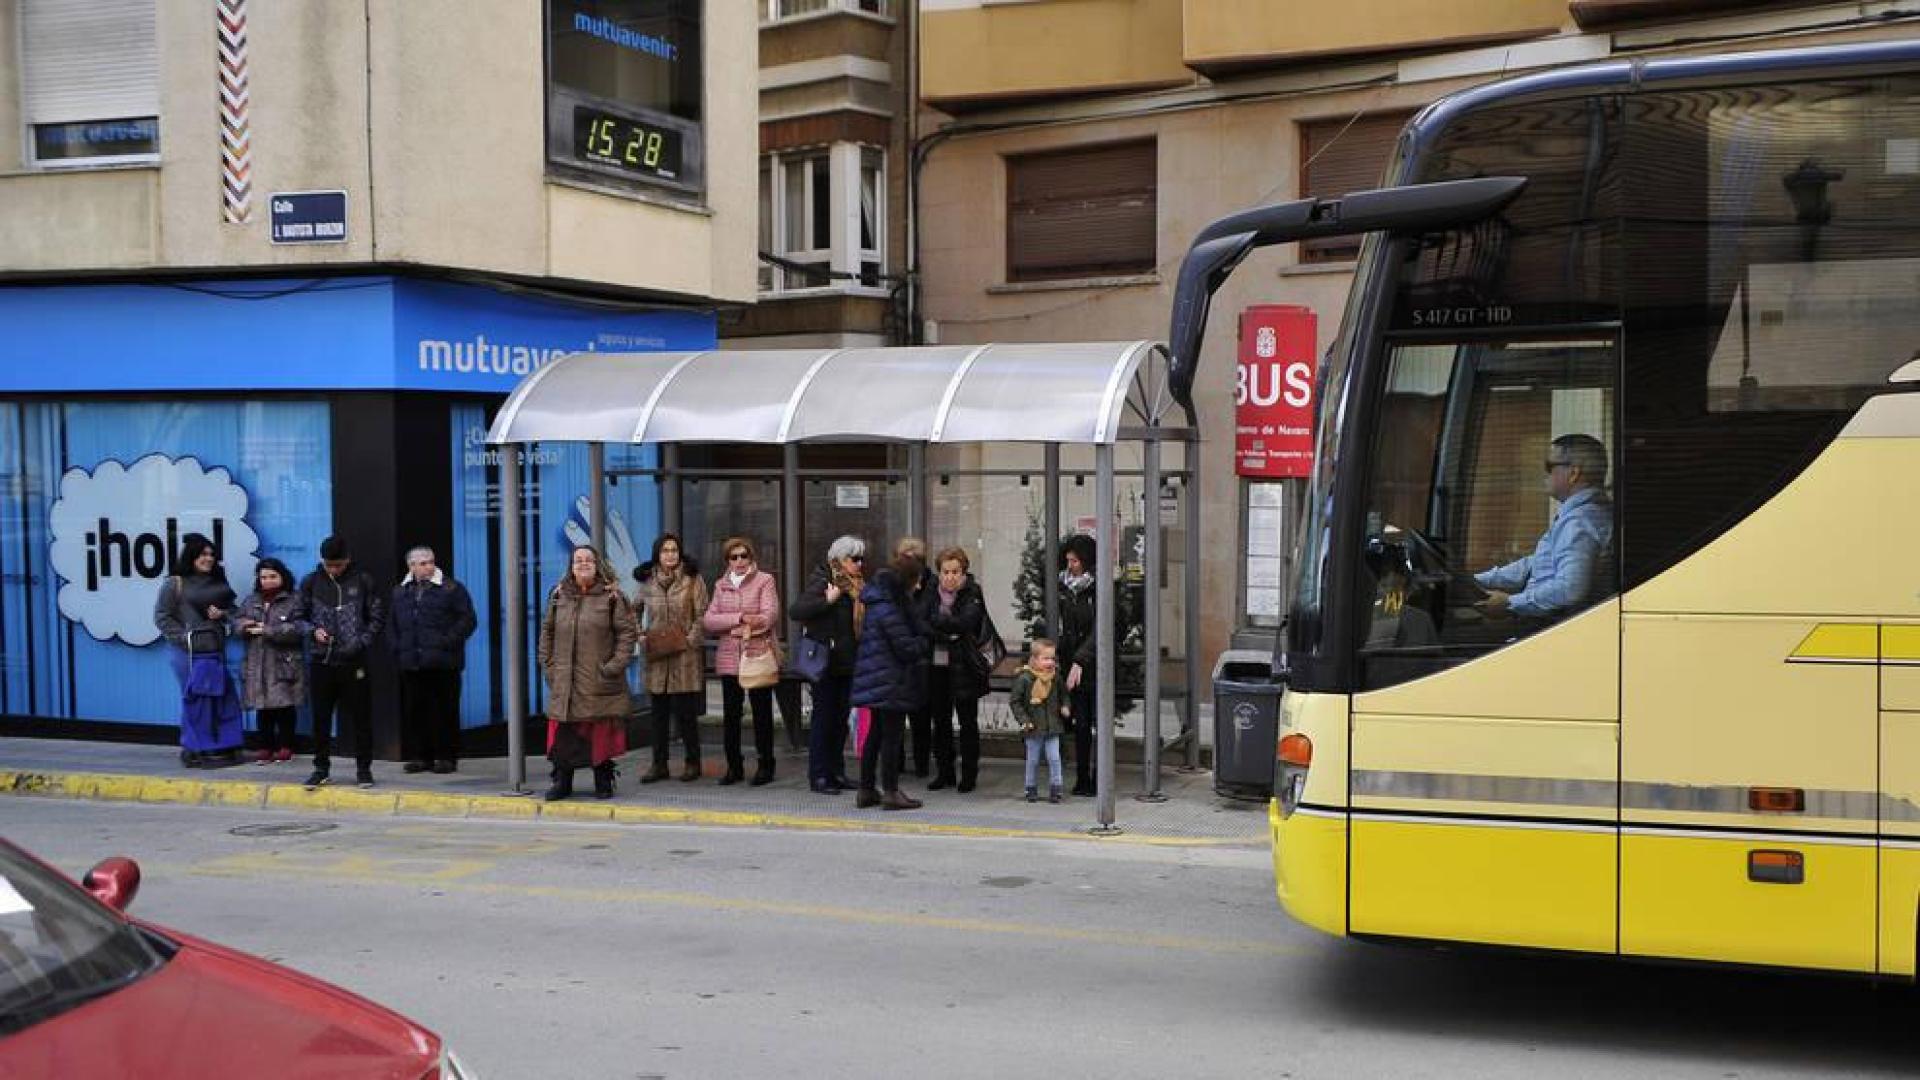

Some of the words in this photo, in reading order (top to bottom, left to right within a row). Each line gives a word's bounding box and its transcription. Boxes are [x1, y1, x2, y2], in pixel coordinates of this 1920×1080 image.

[588, 119, 615, 156] 15
[625, 127, 662, 166] 28
[274, 200, 293, 212] Calle
[418, 334, 595, 375] mutuav
[85, 517, 224, 592] ¡hol!
